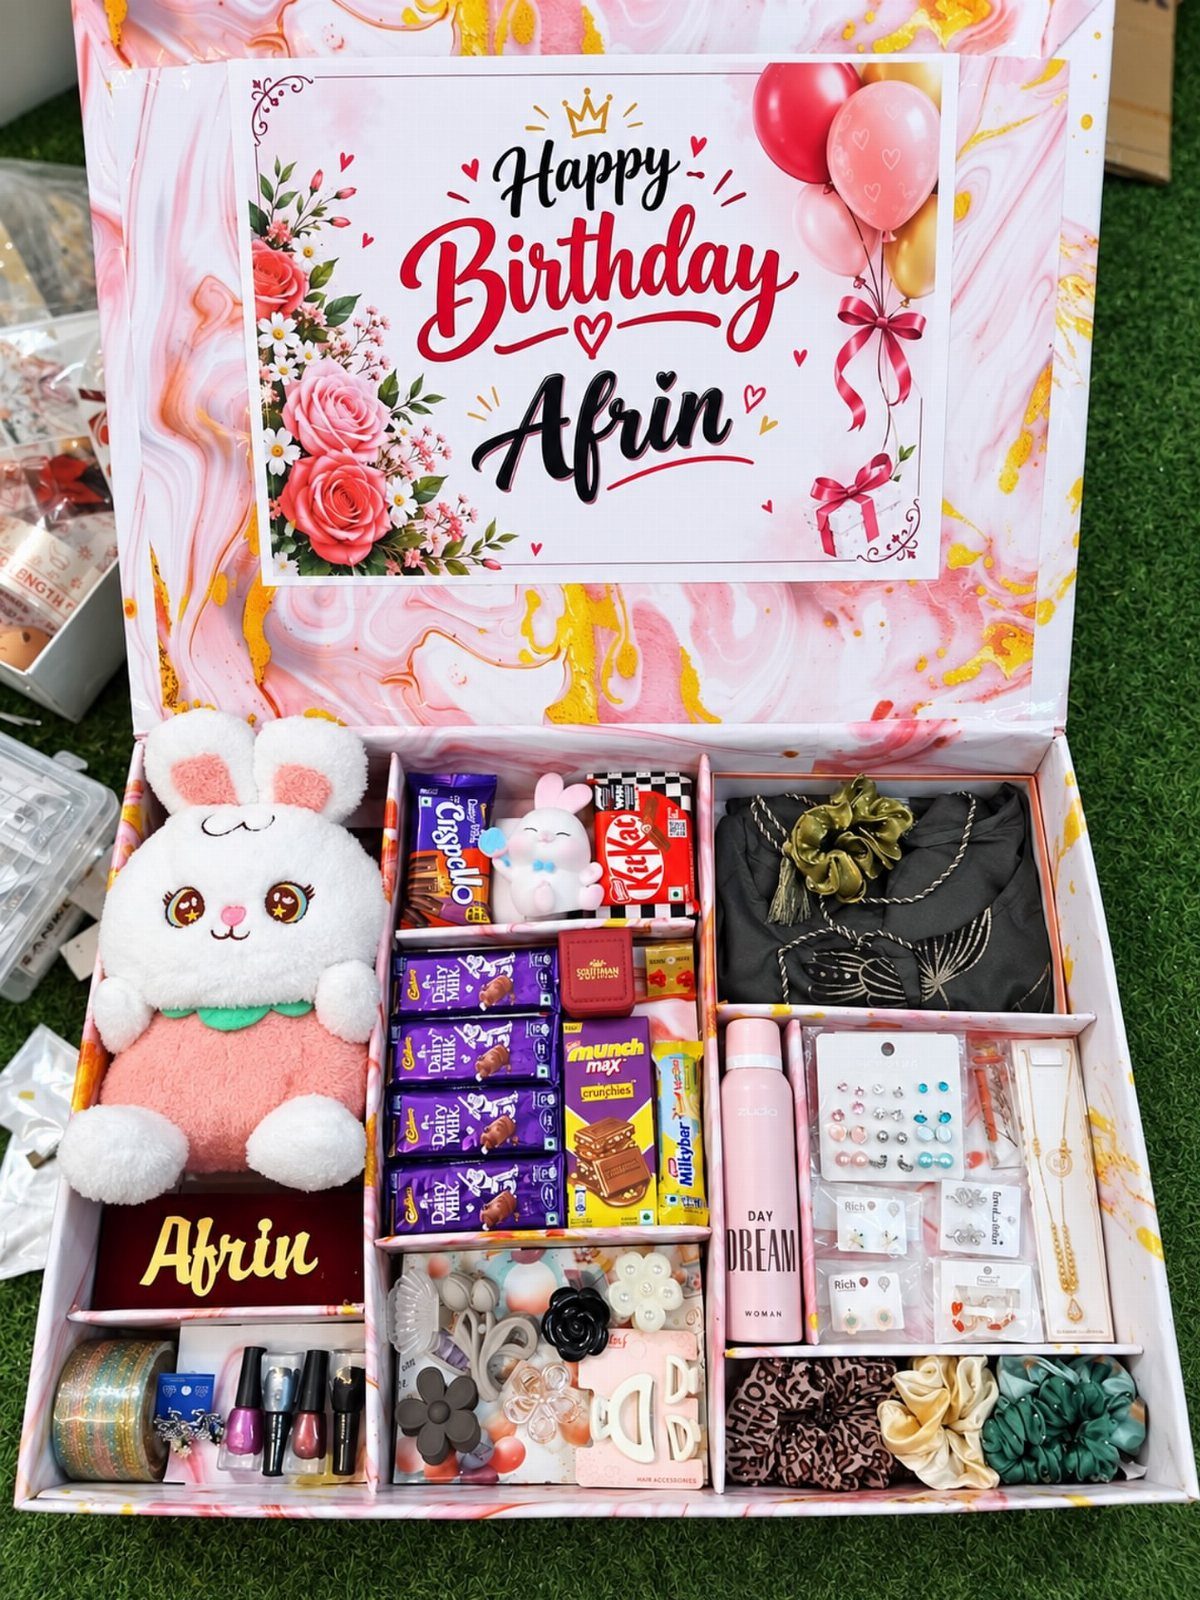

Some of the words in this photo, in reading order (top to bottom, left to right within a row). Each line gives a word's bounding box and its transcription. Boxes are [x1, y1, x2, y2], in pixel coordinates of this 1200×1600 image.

[493, 138, 680, 218] Happy
[399, 204, 799, 362] Birthday
[472, 370, 733, 504] Afrin
[606, 817, 663, 891] KitKat
[432, 965, 448, 1003] Dairy
[427, 1033, 444, 1074] Dairy
[566, 1038, 645, 1063] munch
[585, 1058, 621, 1077] max
[582, 1086, 632, 1099] crunchies
[431, 1104, 448, 1147] Dairy
[430, 1181, 448, 1225] Dairy
[747, 1210, 774, 1222] DAY
[844, 1201, 866, 1211] Rich
[139, 1215, 318, 1297] Afrin
[727, 1228, 796, 1273] DREAM
[834, 1278, 856, 1290] Rich
[744, 1310, 782, 1318] WOMAN
